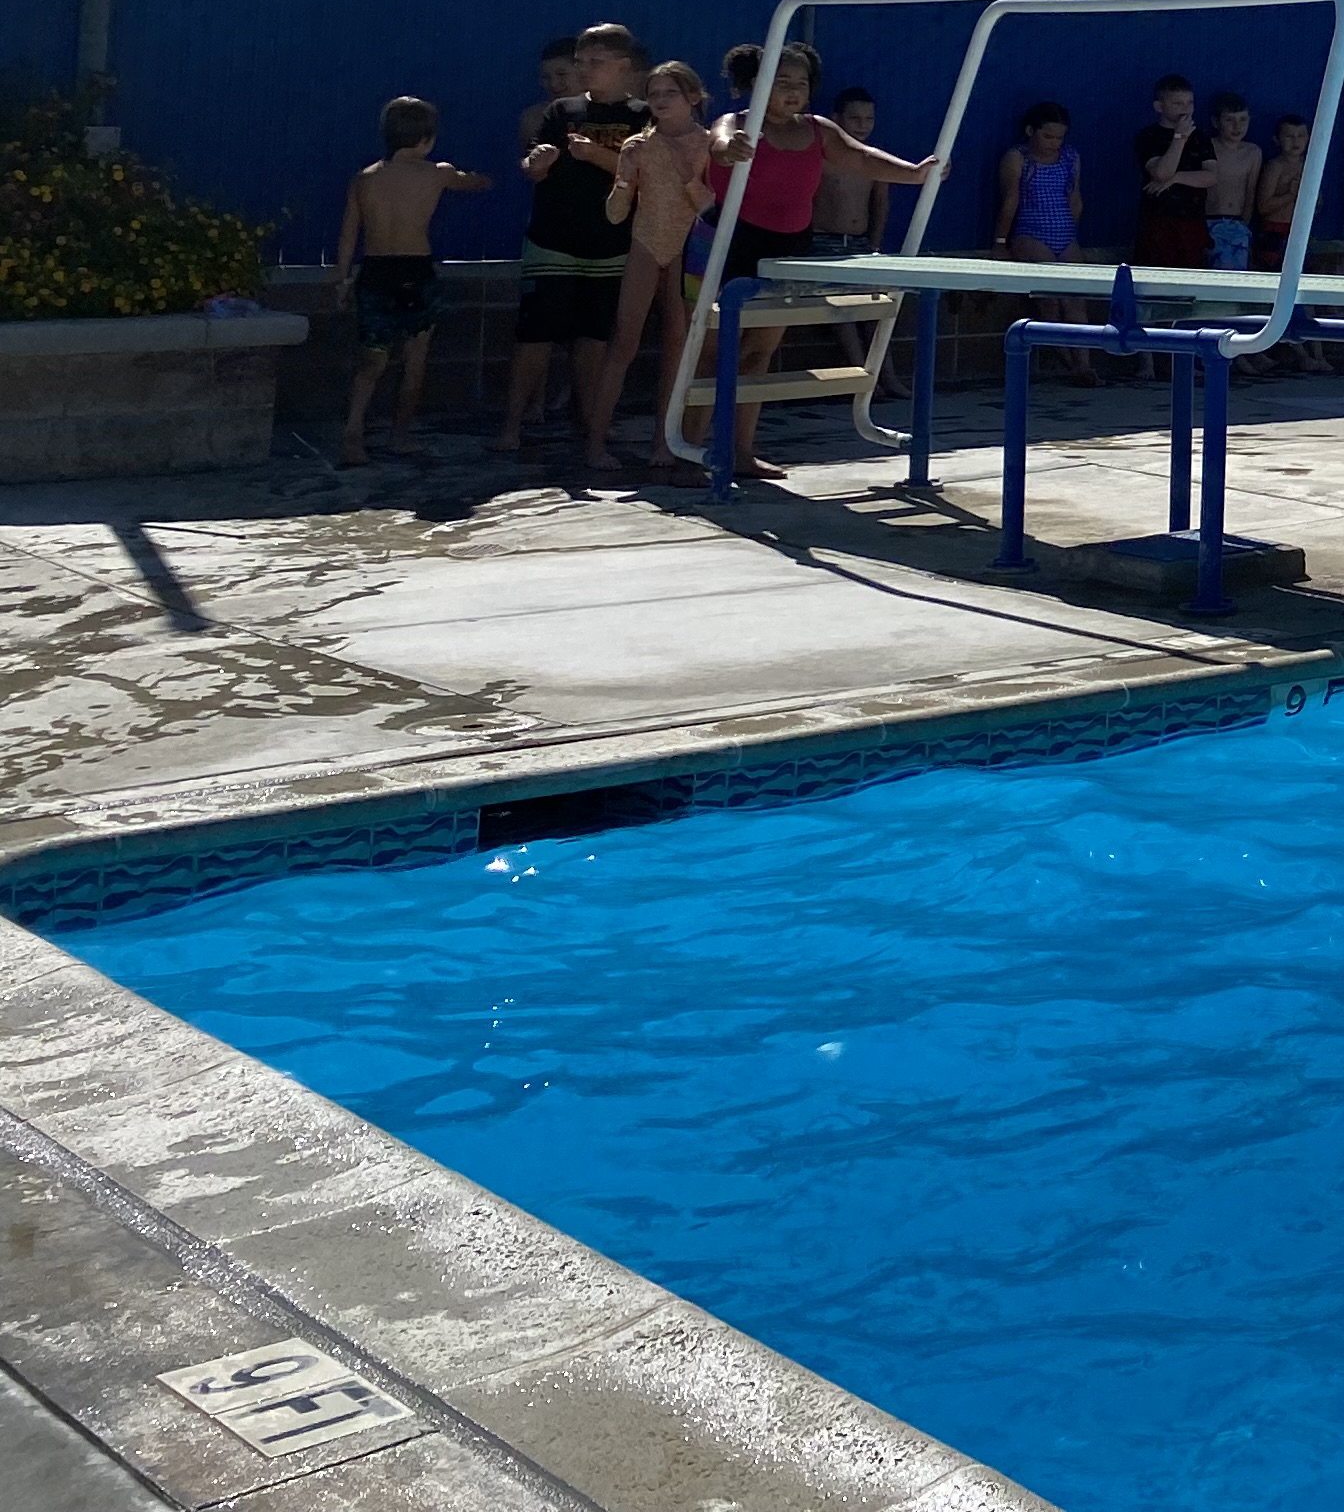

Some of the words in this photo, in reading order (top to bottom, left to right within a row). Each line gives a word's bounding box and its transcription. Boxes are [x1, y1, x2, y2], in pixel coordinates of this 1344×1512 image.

[1284, 685, 1307, 717] 9
[189, 1354, 319, 1395] 9
[233, 1380, 400, 1445] FT
